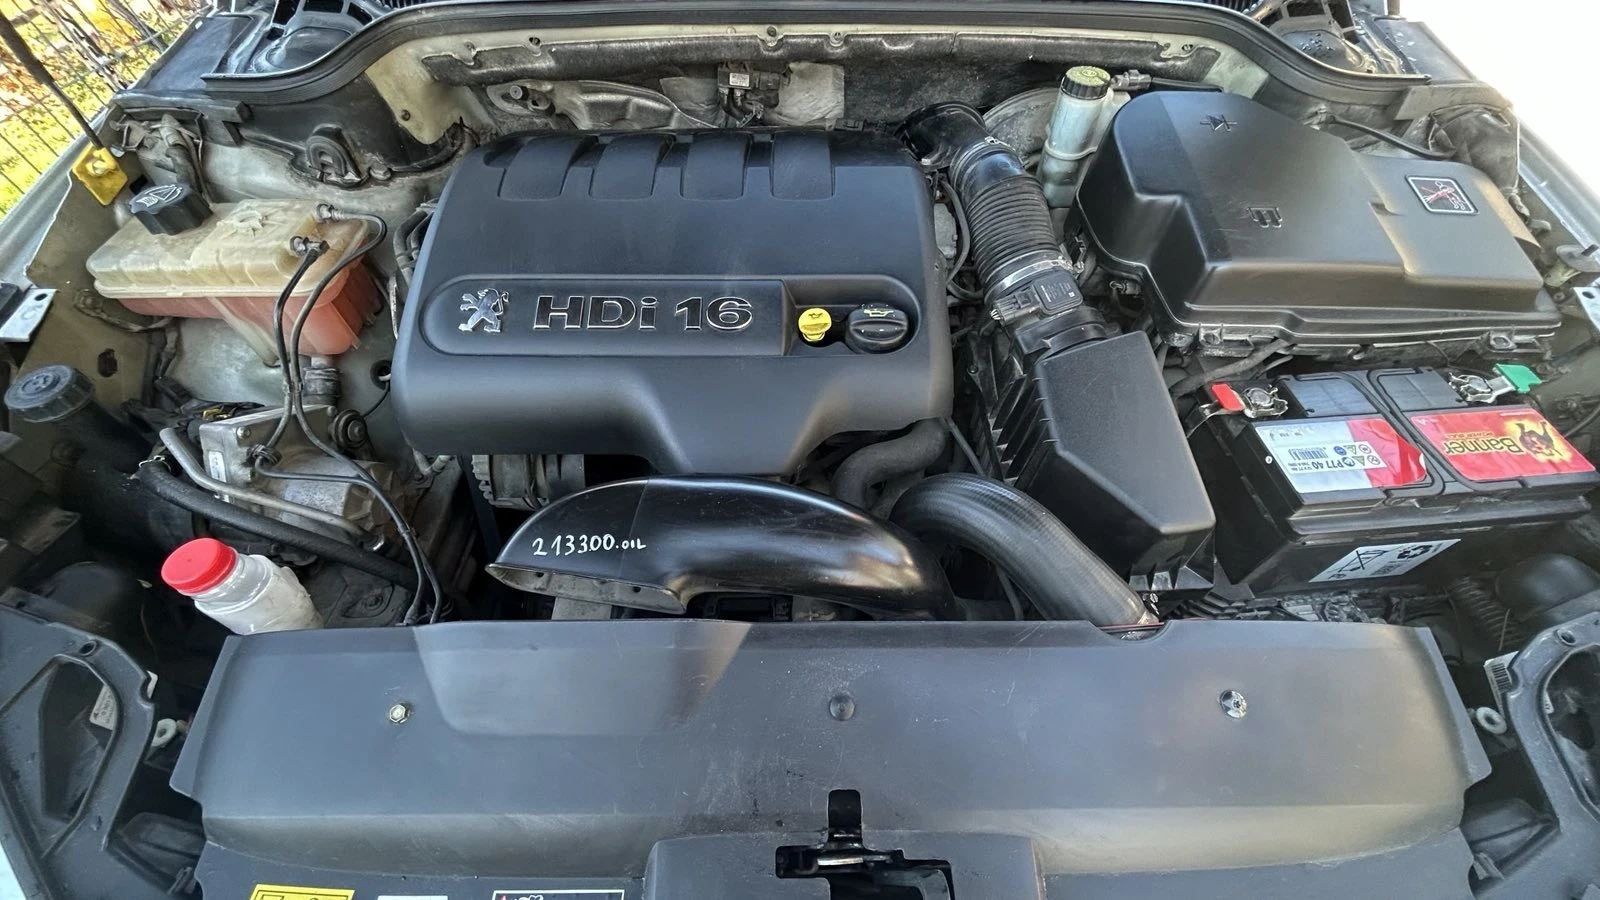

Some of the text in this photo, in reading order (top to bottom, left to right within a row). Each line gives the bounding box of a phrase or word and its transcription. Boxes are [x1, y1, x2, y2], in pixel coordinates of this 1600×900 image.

[533, 295, 753, 332] HDi 16
[1443, 437, 1524, 454] Banner
[1312, 461, 1324, 470] 40
